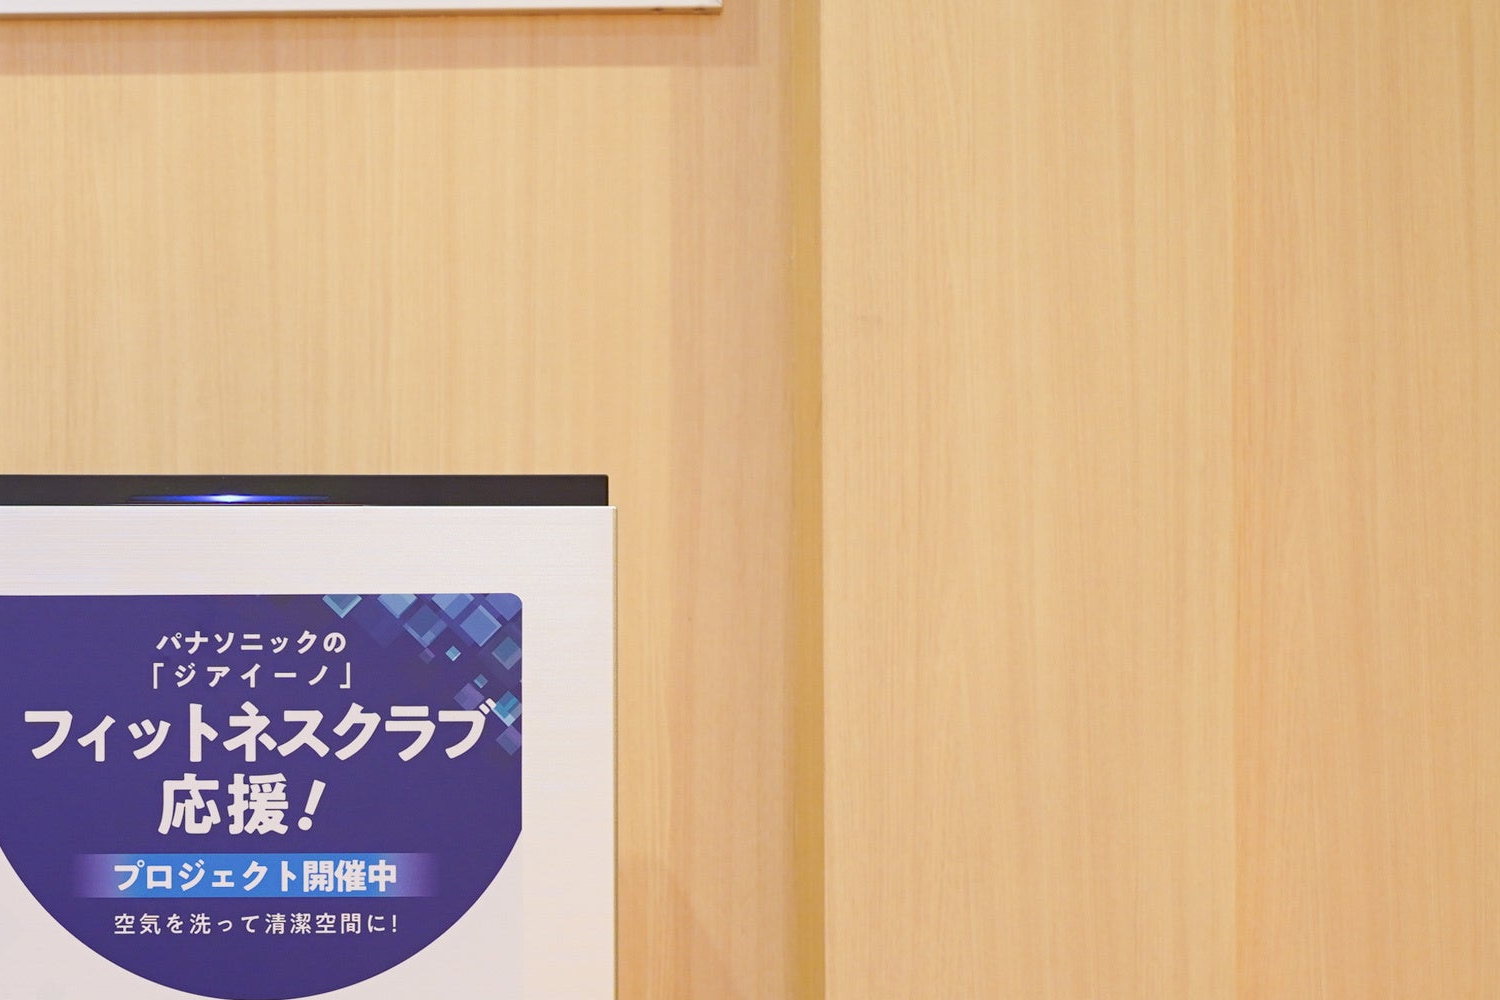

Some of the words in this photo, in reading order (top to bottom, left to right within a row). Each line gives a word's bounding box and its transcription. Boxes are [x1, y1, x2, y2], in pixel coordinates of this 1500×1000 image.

[155, 630, 347, 654] パナソニックの
[152, 661, 353, 690] 「ジアイーノ」
[23, 697, 498, 763] フィットネスクラブ
[157, 773, 327, 835] 応援!
[113, 858, 398, 893] プロジェクト開催中
[113, 912, 399, 935] 空気を洗って清潔空間に!
